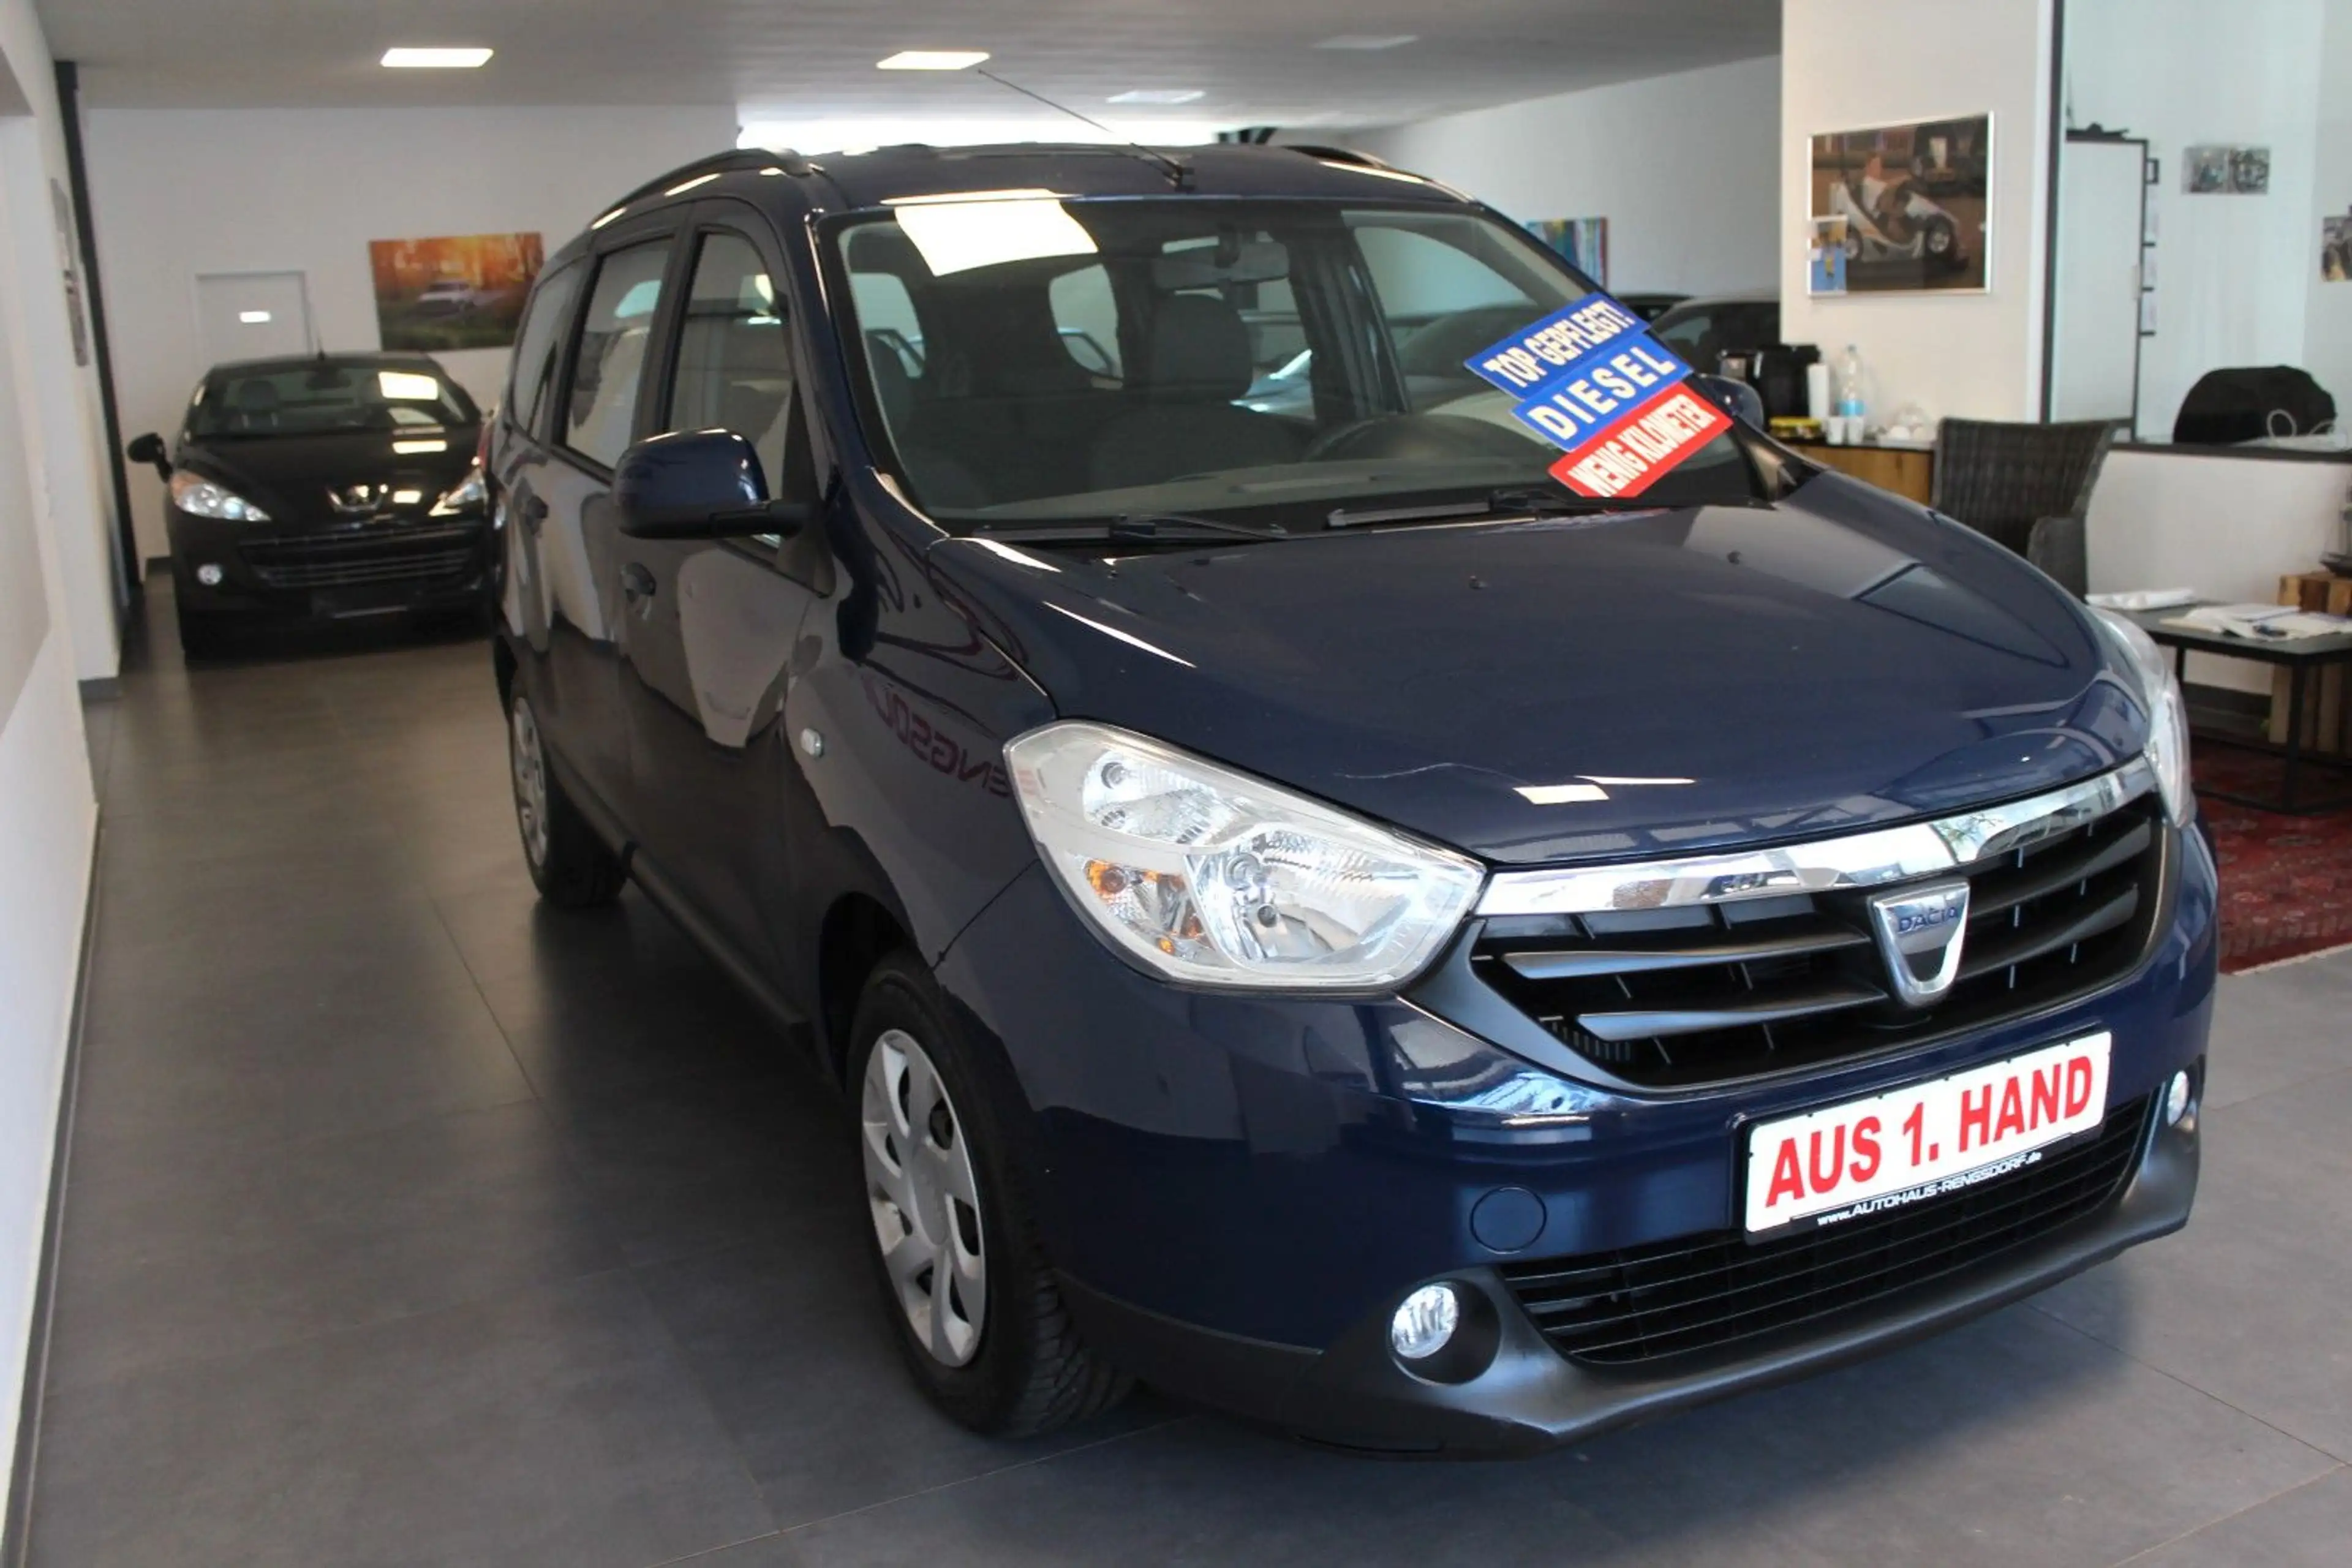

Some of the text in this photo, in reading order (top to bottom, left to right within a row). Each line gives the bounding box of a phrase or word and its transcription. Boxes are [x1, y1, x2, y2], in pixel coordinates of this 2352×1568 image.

[1482, 300, 1636, 388] TOP GEPFLEGT!
[1528, 346, 1677, 440] DIESEL
[1567, 394, 1717, 497] WENIG KILOMETER
[1899, 907, 1958, 930] DACIA
[1765, 1055, 2093, 1208] AUS 1. HAND
[1817, 1152, 2042, 1225] www.AUTOHAUS-RENGSDORF.de
